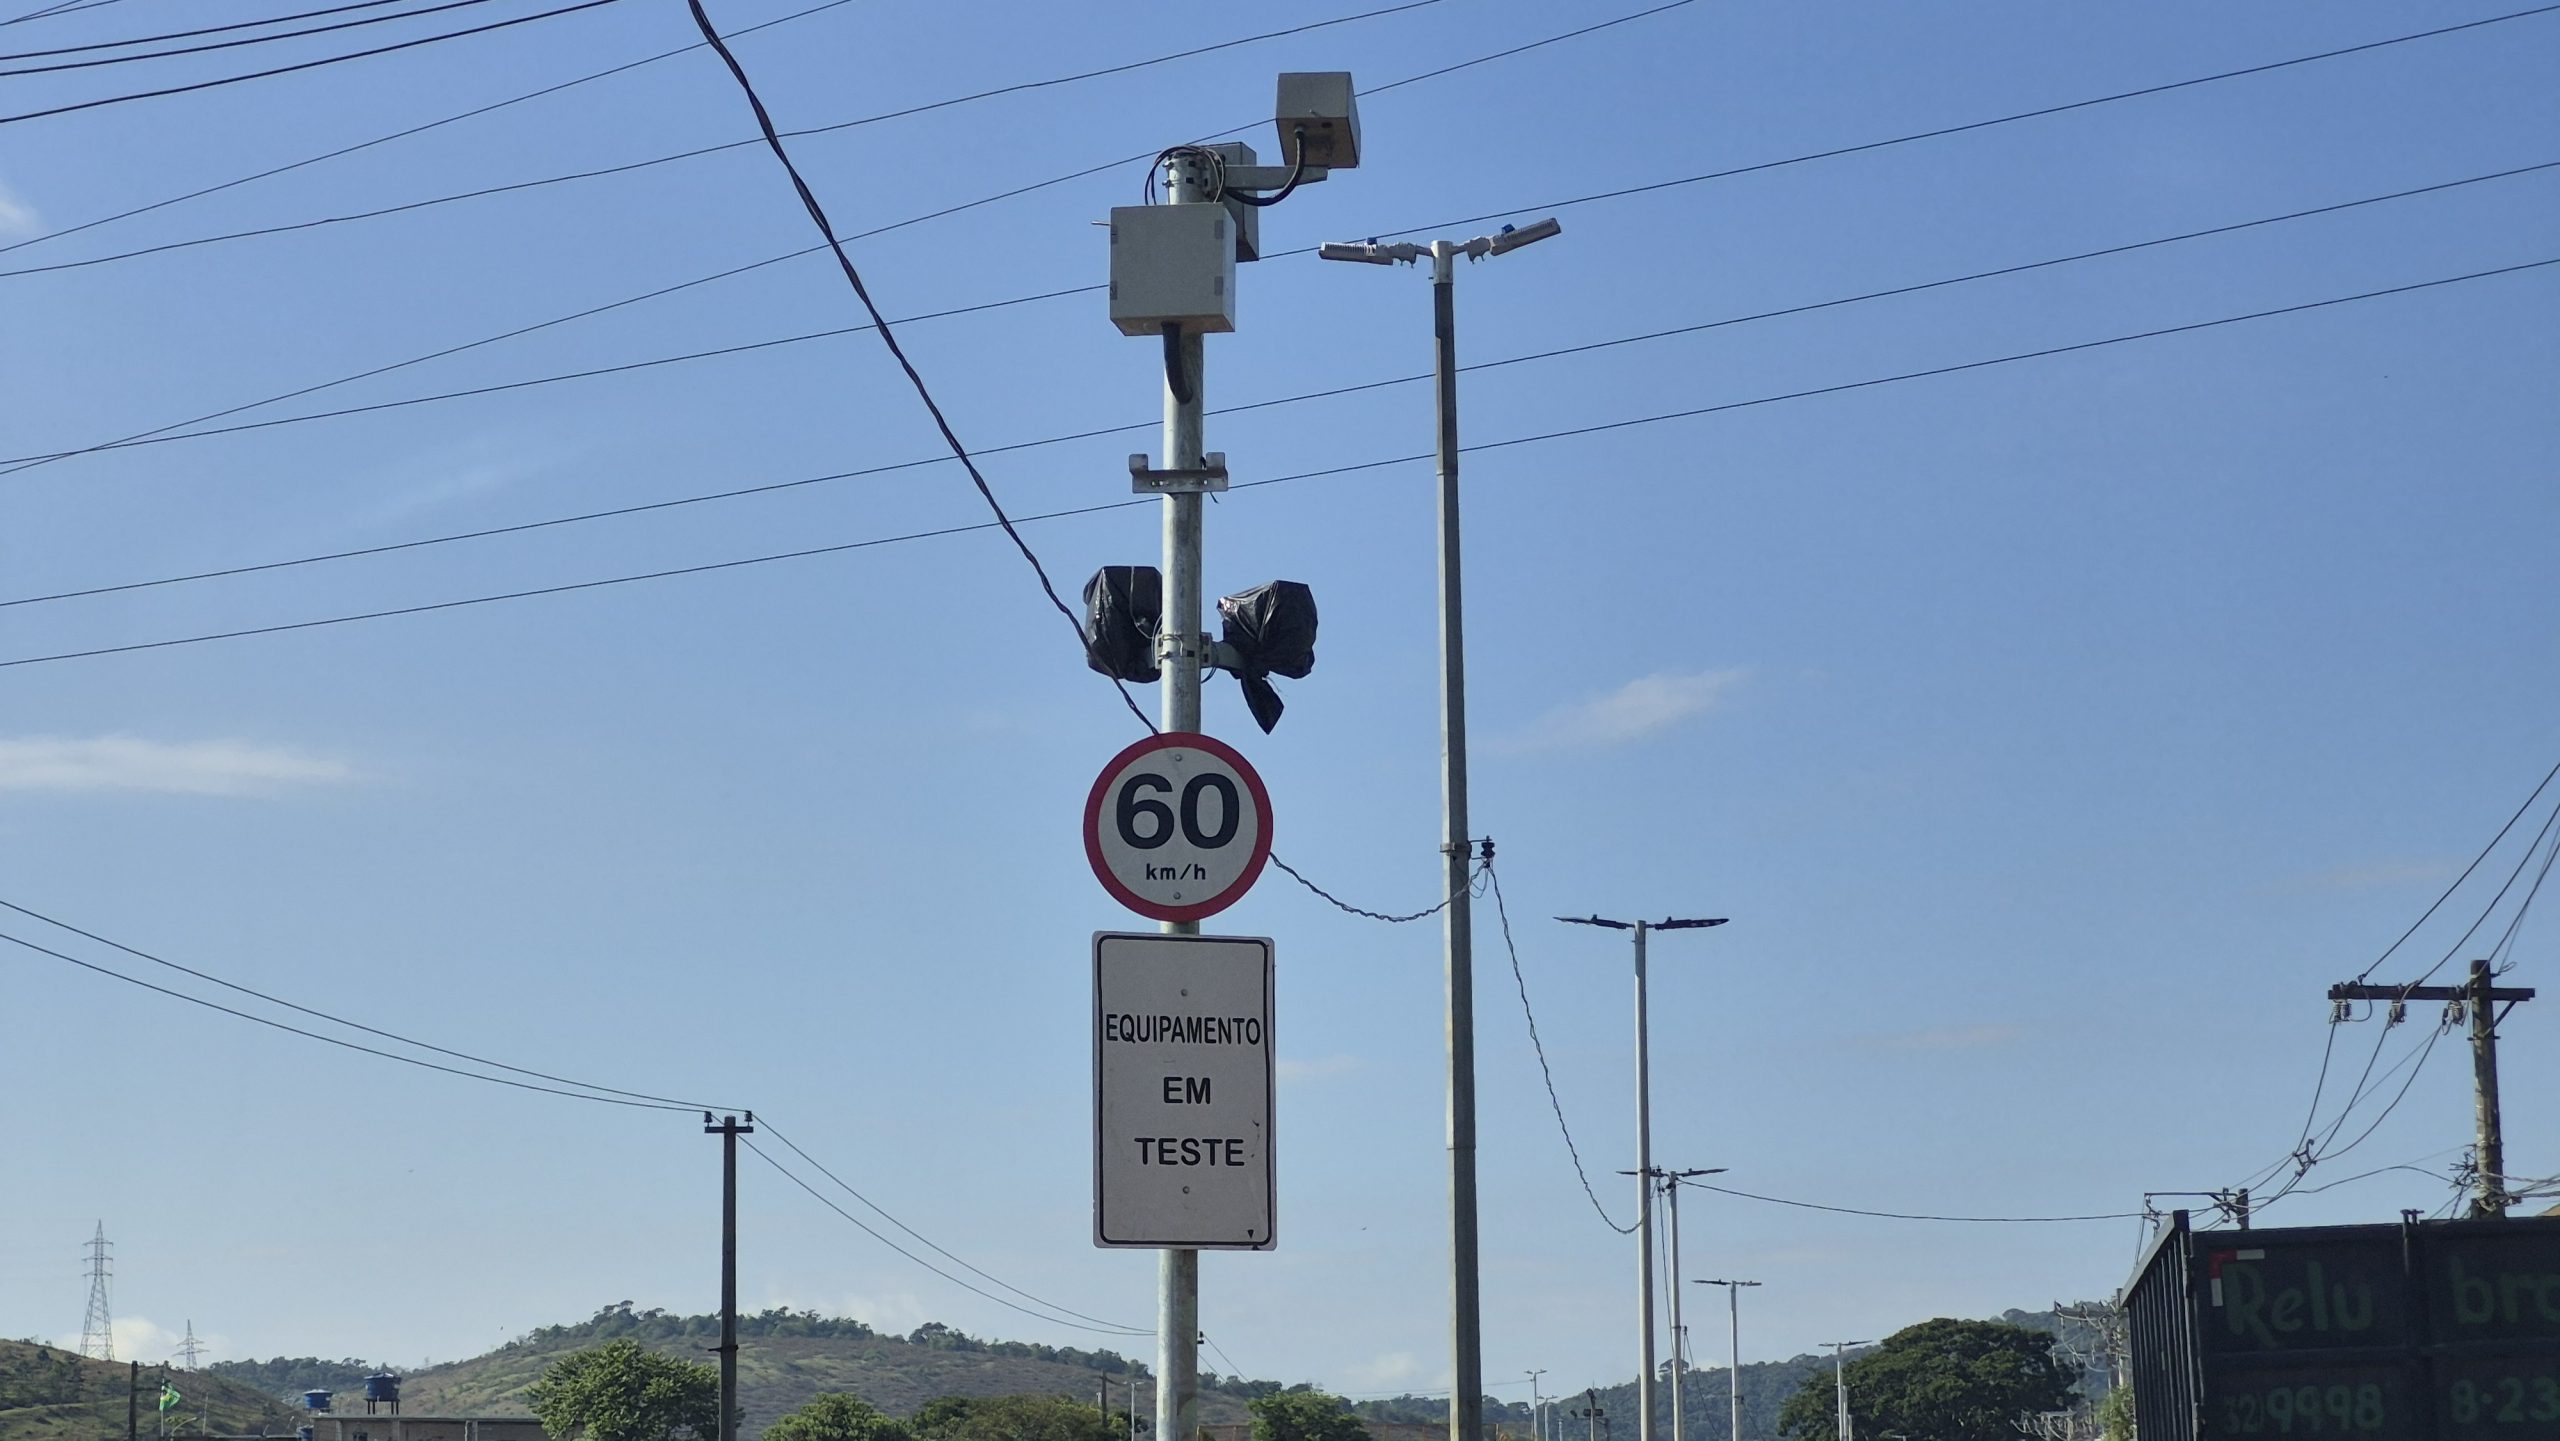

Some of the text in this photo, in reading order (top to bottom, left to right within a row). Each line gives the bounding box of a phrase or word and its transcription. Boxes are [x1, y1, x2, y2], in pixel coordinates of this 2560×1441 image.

[1116, 773, 1239, 849] 60
[1146, 863, 1206, 880] km/h
[1106, 1013, 1261, 1045] EQUIPAMENTO
[1163, 1076, 1211, 1104] EM
[1134, 1138, 1245, 1166] TESTE
